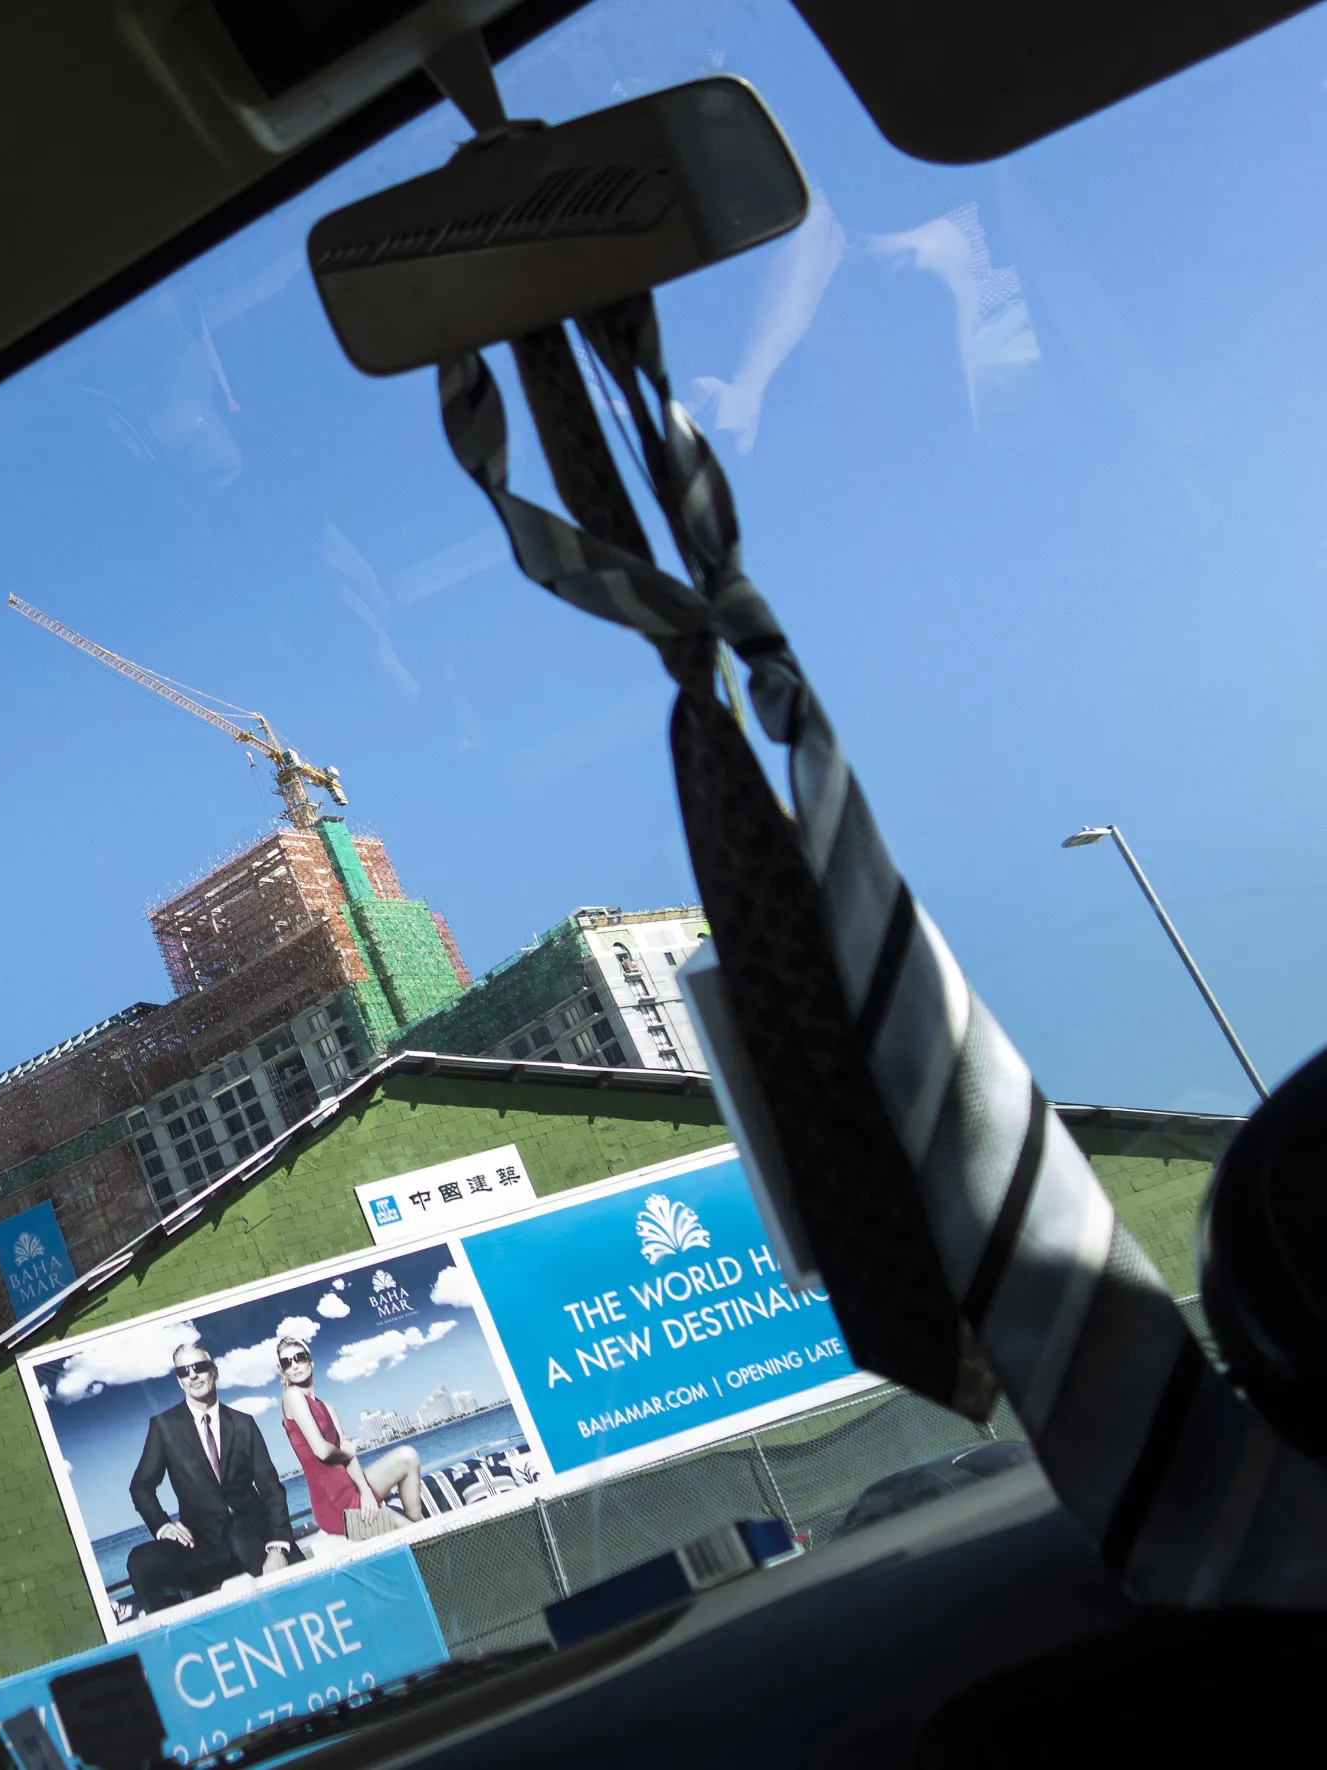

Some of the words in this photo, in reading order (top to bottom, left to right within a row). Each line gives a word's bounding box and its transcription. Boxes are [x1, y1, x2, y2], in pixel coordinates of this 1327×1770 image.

[9, 1256, 62, 1289] BAHA
[20, 1273, 68, 1302] MAR
[563, 1291, 626, 1332] THE
[628, 1256, 743, 1311] WORLD
[748, 1244, 781, 1276] H
[369, 1287, 409, 1308] BAHA
[377, 1299, 414, 1318] MAR
[548, 1356, 573, 1389] A
[575, 1326, 651, 1377] NEW
[577, 1382, 709, 1438] BAHAMAR.COM
[726, 1351, 803, 1388] OPENING
[804, 1337, 844, 1363] LATE
[174, 1600, 362, 1708] CENTRE
